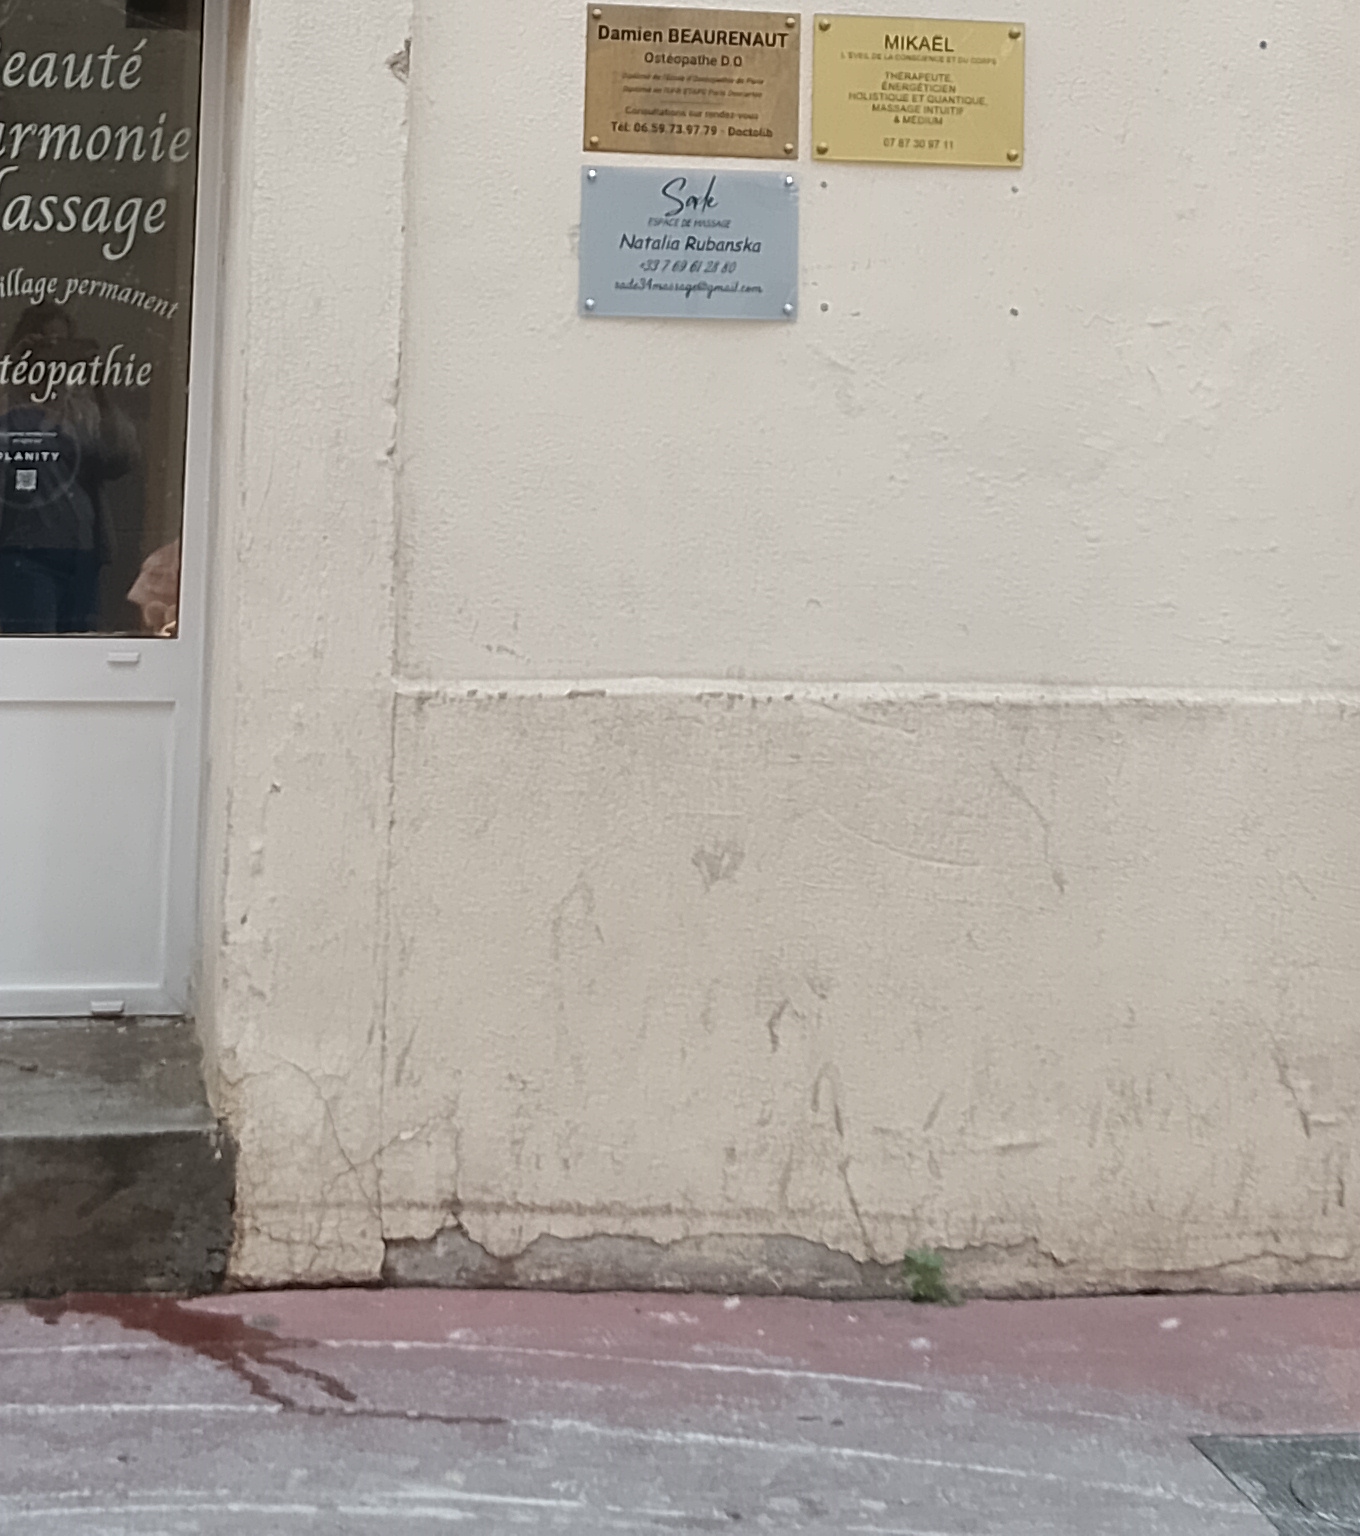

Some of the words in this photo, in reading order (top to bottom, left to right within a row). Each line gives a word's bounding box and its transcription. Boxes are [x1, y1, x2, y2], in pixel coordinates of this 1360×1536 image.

[597, 24, 663, 43] Damien
[668, 27, 789, 48] BEAURENAUT
[884, 33, 955, 53] MIKAËL
[643, 51, 718, 67] Ostéopathe
[911, 93, 924, 103] ET
[871, 103, 921, 114] MASSAGE
[727, 126, 773, 138] Doctolib
[647, 217, 679, 227] ESPACE
[680, 218, 692, 227] DE
[619, 233, 681, 251] Natalia
[684, 235, 762, 253] Rubanska
[54, 276, 180, 319] permanent
